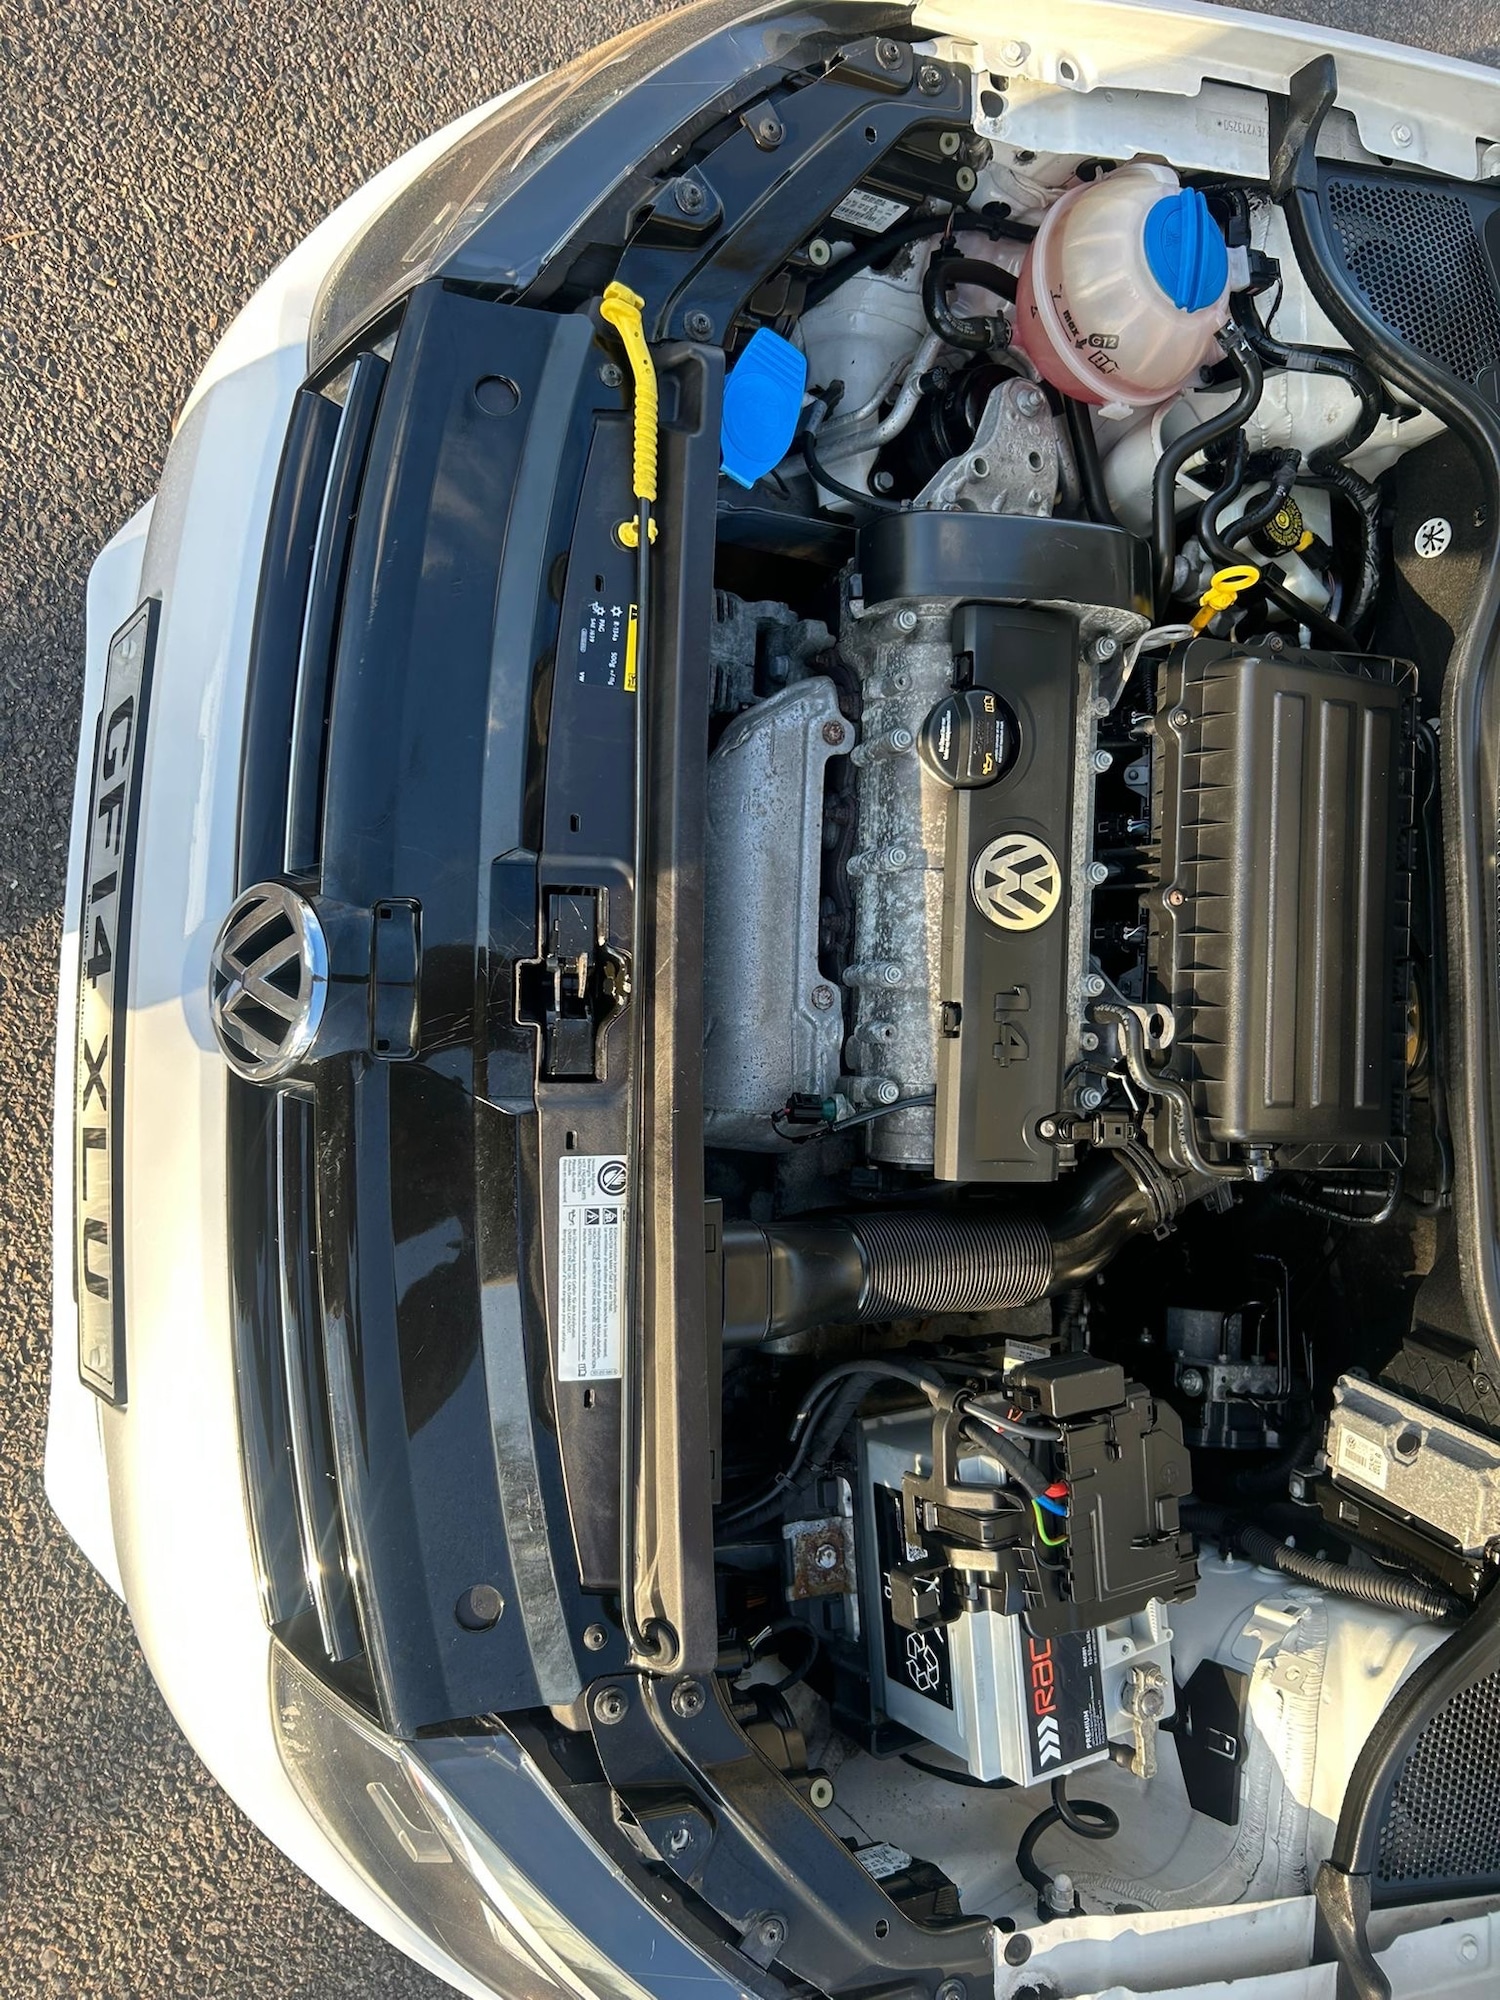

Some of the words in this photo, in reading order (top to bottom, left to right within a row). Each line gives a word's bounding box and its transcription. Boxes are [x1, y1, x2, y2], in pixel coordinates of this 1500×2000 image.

[1063, 310, 1080, 337] max
[1092, 336, 1117, 348] G12
[608, 652, 618, 668] 500g
[579, 672, 585, 682] VW
[87, 695, 133, 989] GF14
[992, 985, 1032, 1068] 1.4
[82, 1034, 109, 1301] XLU
[1082, 1710, 1092, 1748] PREMIUM
